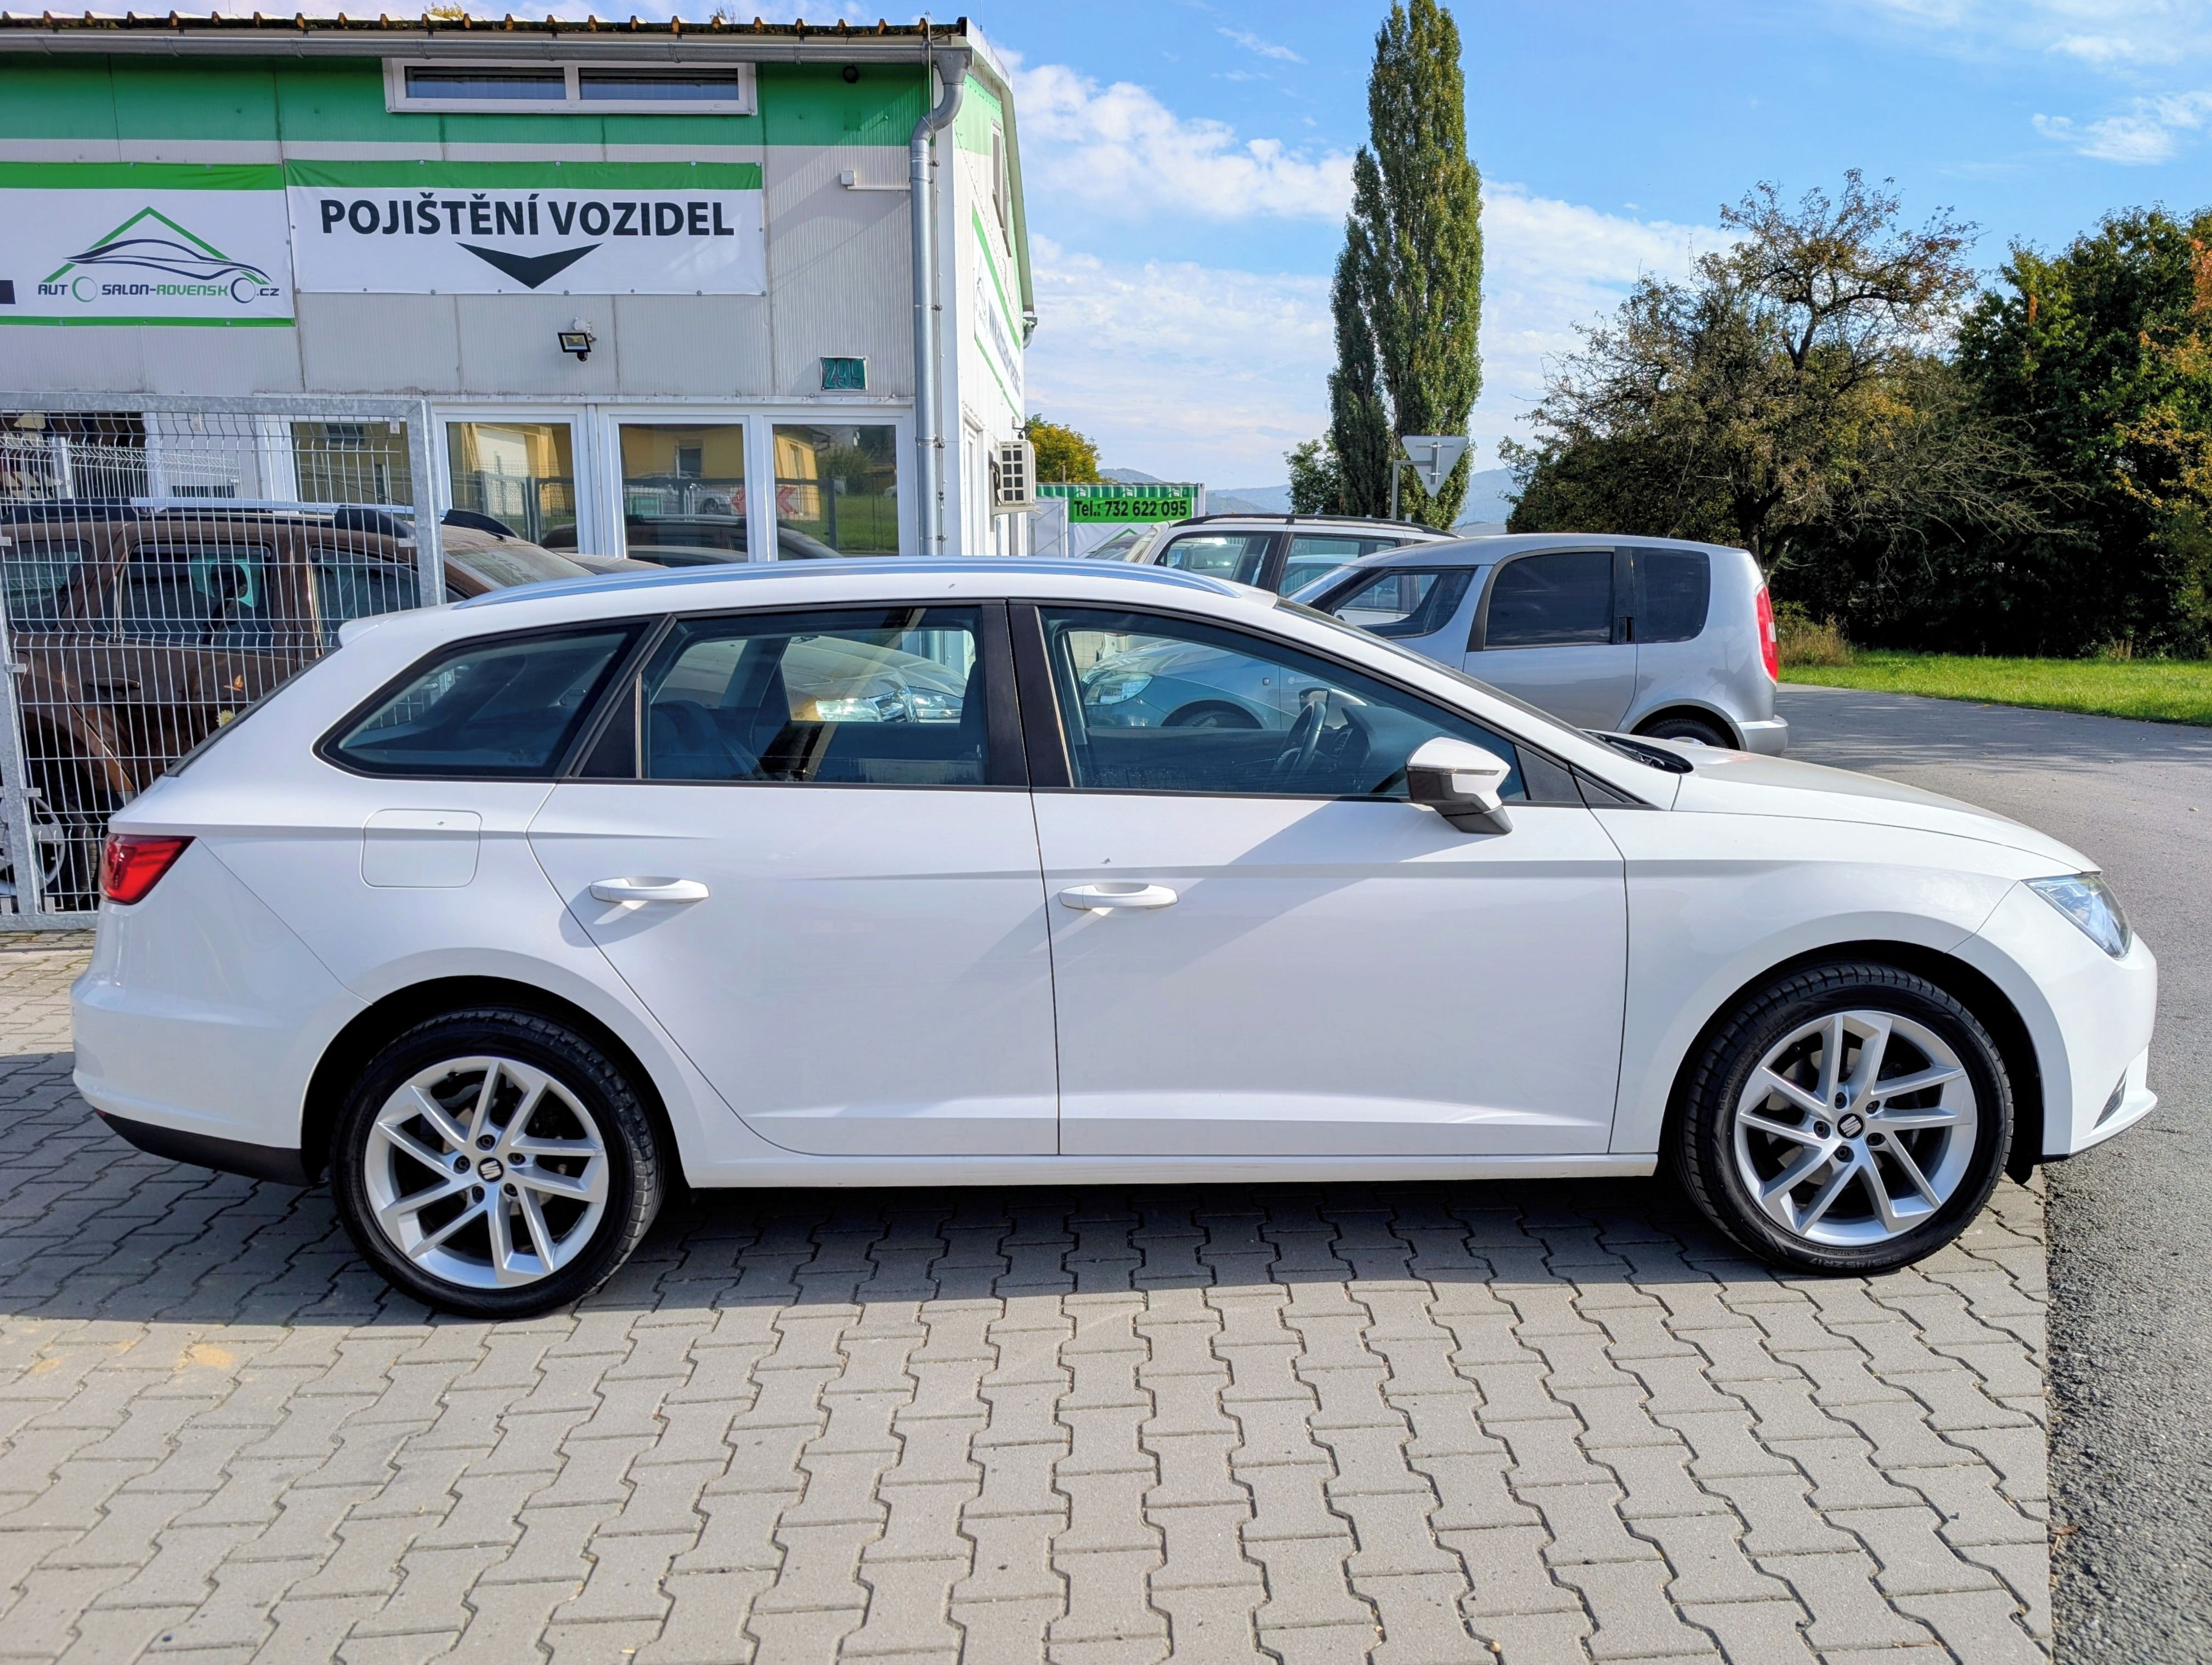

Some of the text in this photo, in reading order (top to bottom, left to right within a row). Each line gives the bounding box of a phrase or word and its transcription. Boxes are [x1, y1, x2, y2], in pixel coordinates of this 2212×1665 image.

[320, 192, 734, 236] POJIŠTĚNÍ VOZIDEL
[824, 359, 864, 388] 299
[1074, 500, 1187, 517] Tel.: 732 622 095
